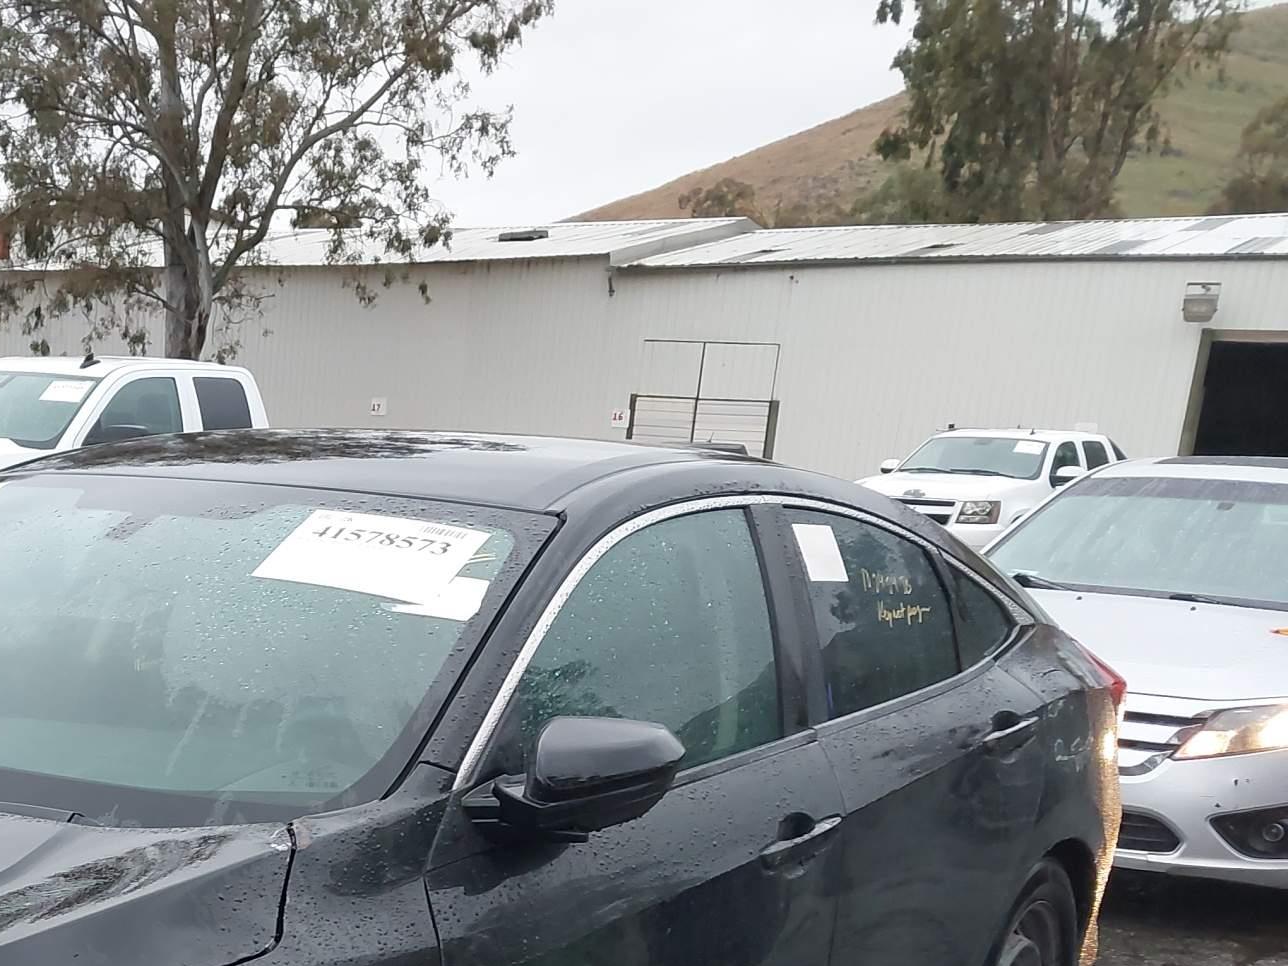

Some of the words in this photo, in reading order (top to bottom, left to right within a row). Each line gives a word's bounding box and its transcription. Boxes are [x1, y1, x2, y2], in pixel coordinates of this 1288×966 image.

[371, 402, 382, 412] 17
[612, 412, 623, 421] 16
[312, 525, 452, 556] 41578573
